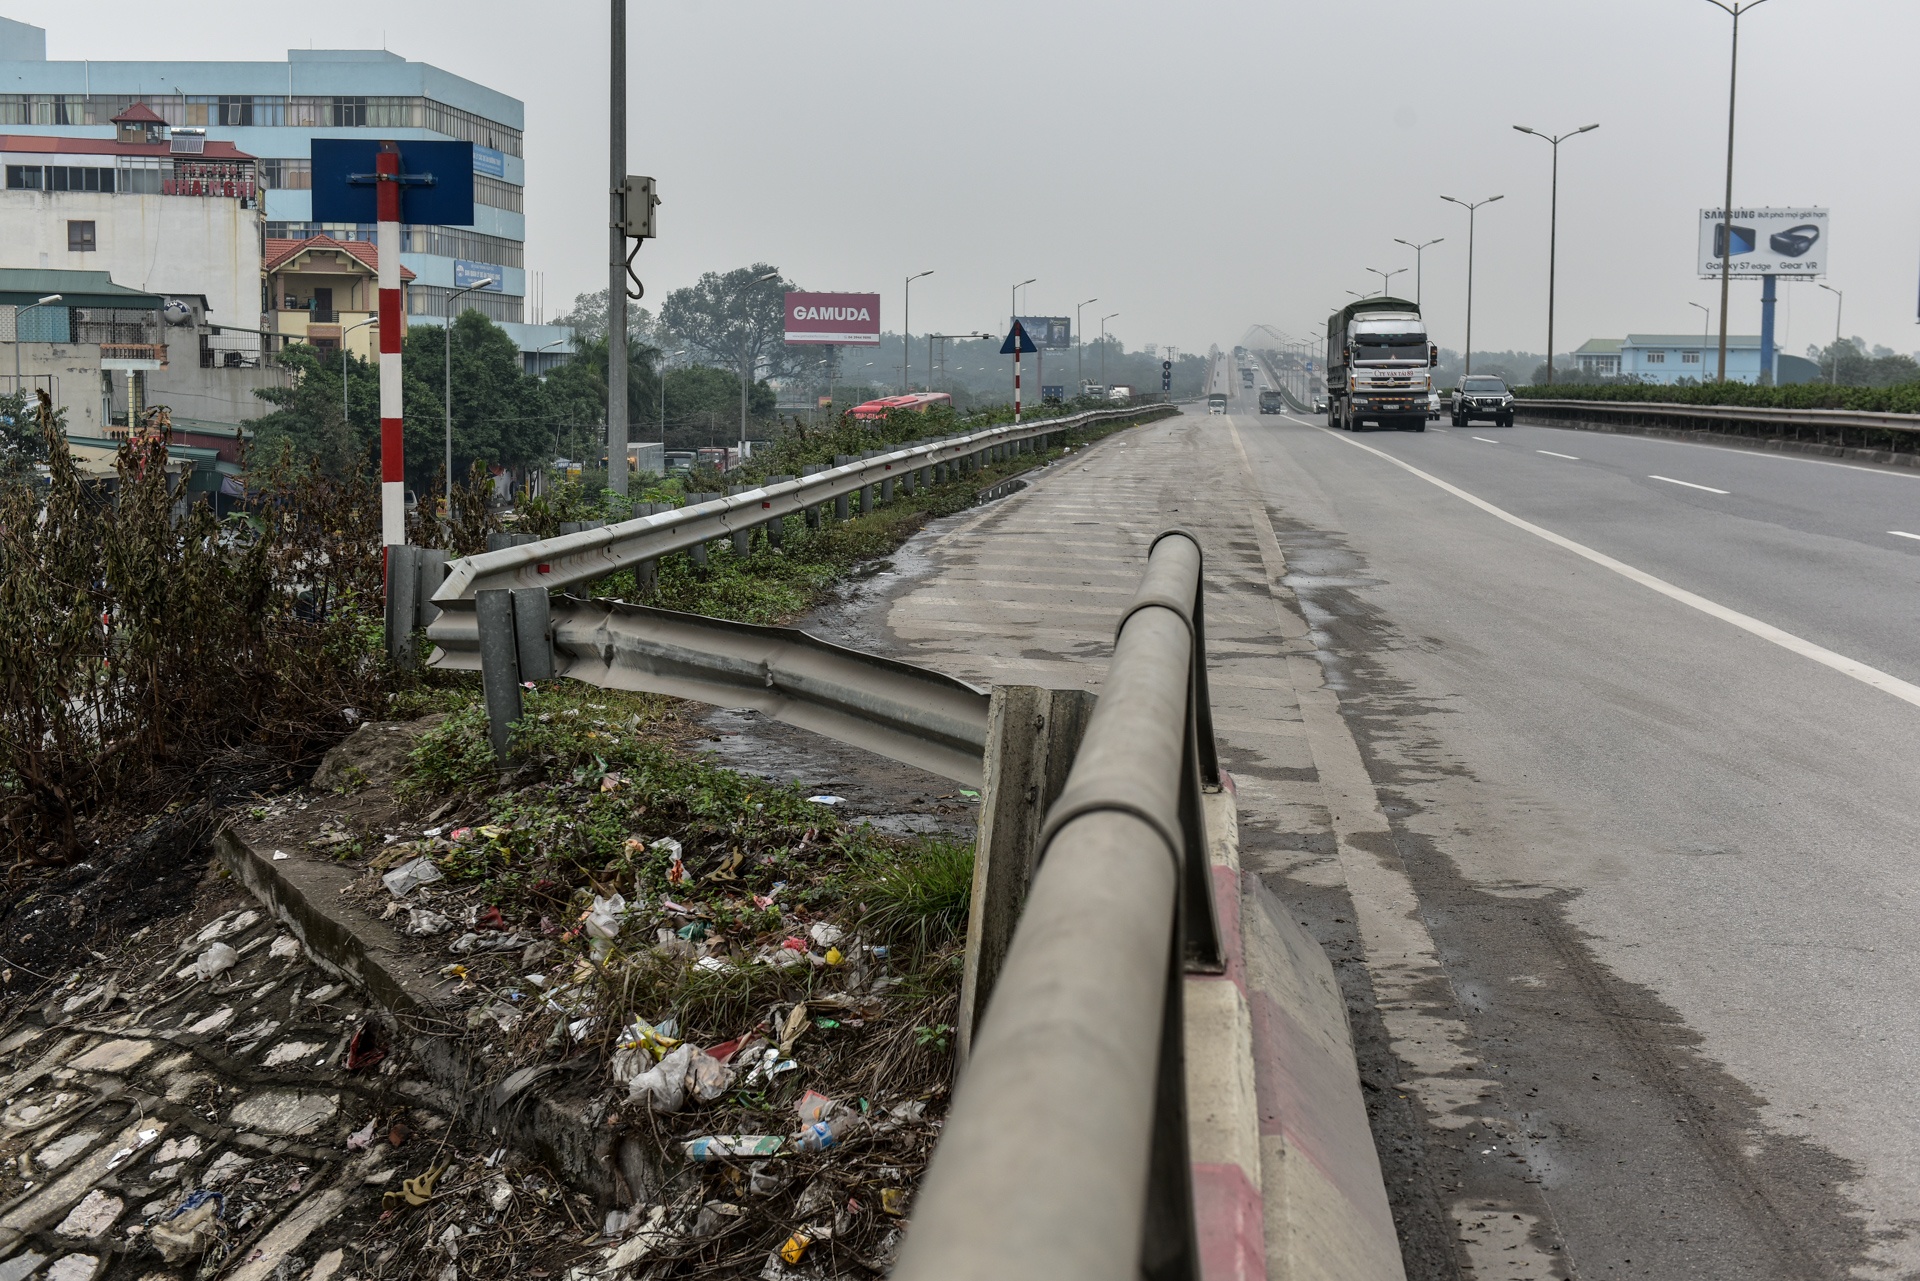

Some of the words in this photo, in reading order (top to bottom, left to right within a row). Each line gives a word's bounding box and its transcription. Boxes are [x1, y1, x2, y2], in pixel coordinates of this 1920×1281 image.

[1704, 210, 1755, 219] SAMSUNG
[1751, 263, 1772, 271] edge
[793, 306, 870, 321] GAMUDA
